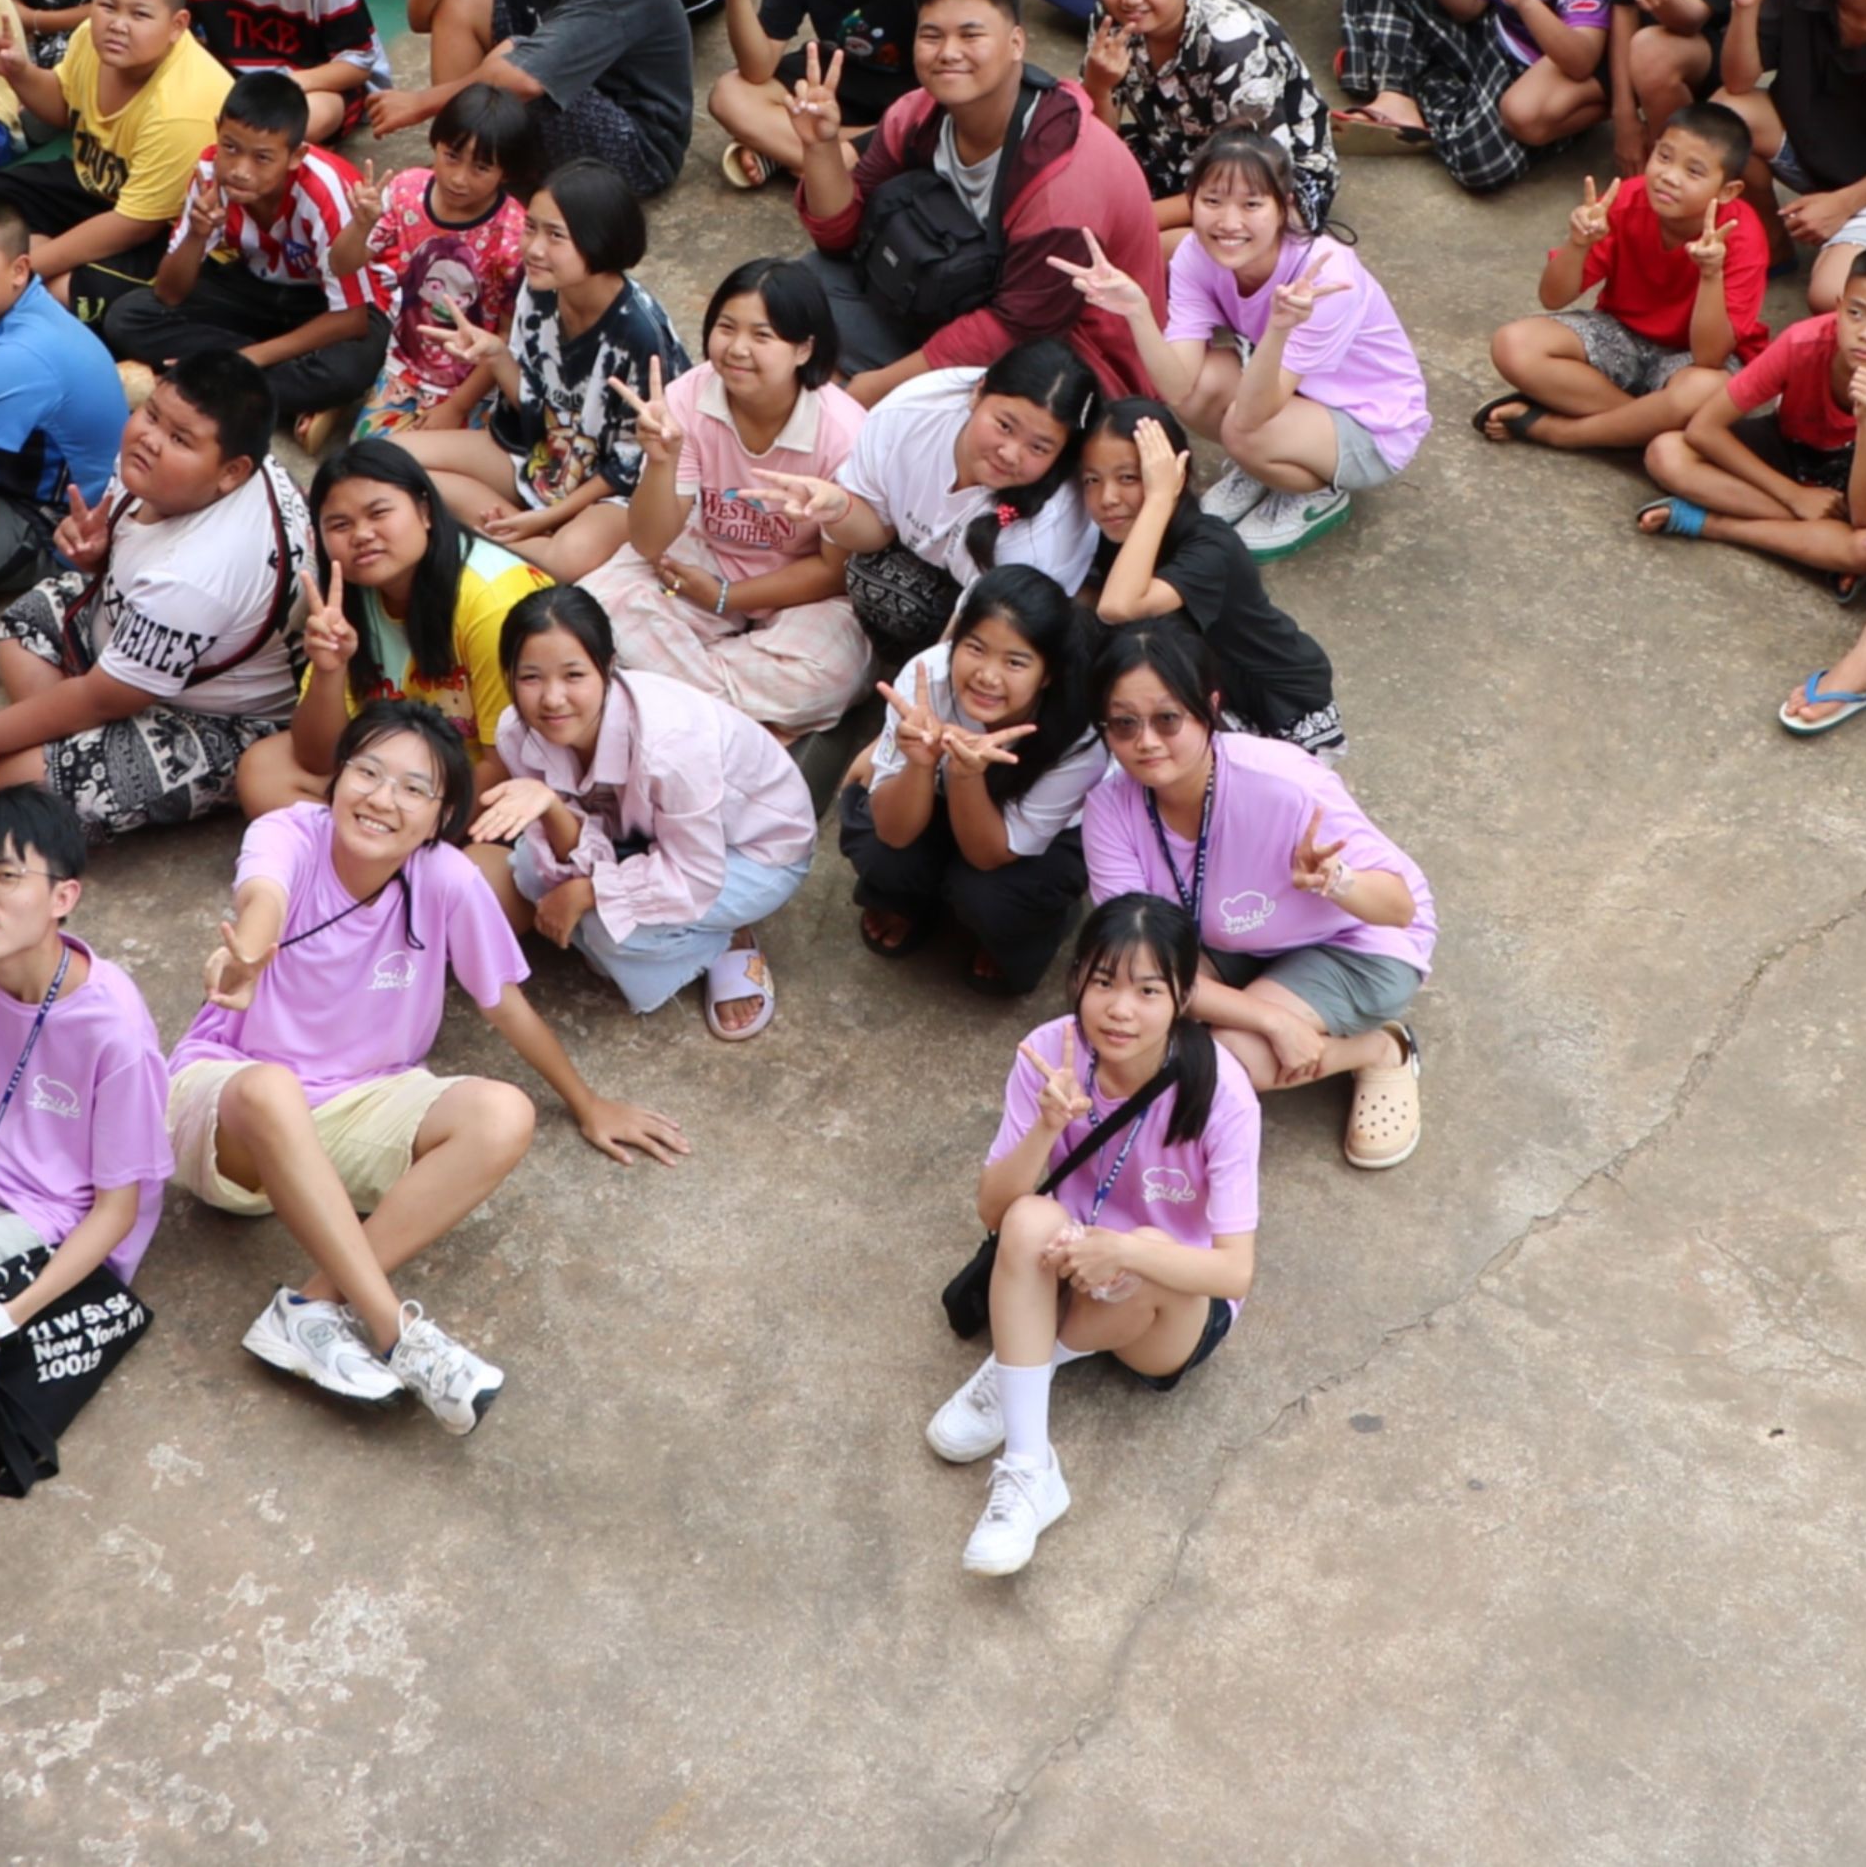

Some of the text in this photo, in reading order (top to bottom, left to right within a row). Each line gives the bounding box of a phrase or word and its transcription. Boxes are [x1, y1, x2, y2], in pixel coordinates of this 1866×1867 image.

[226, 9, 301, 54] TKB
[701, 487, 793, 539] WESTERN
[111, 606, 184, 672] WHITE
[27, 1319, 54, 1343] 11
[53, 1309, 81, 1332] W
[104, 1291, 132, 1315] St
[33, 1335, 83, 1363] New
[36, 1348, 103, 1383] 10019
